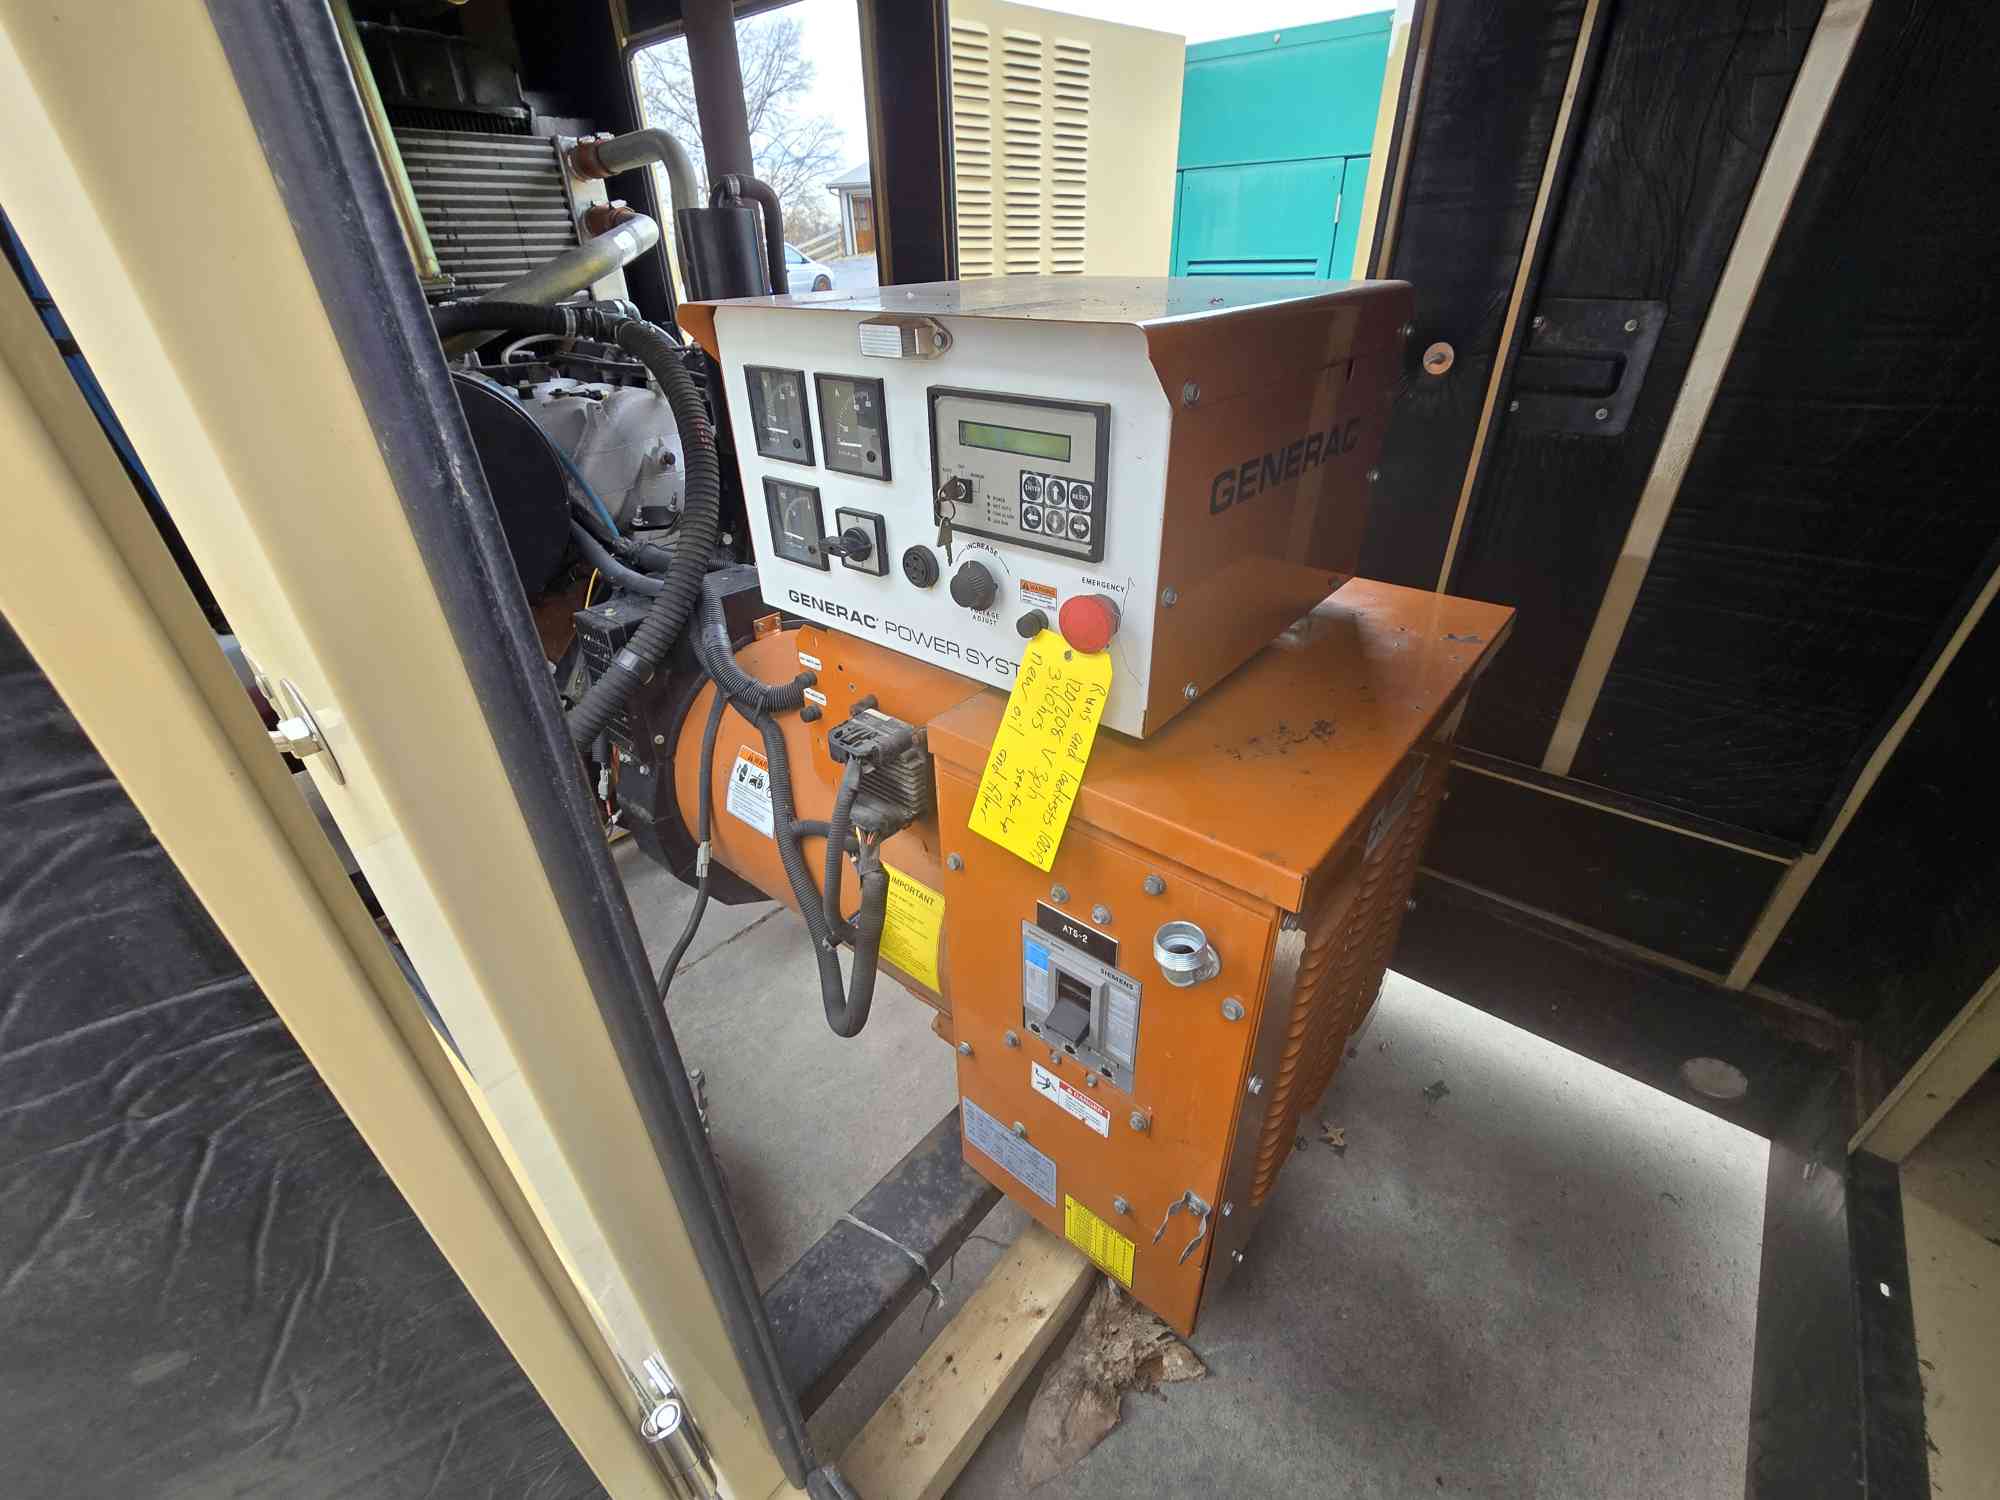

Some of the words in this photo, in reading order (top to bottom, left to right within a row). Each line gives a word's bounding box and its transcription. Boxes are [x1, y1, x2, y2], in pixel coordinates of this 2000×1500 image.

[1210, 417, 1361, 516] GENERAC
[967, 542, 999, 557] INCREASE
[1081, 576, 1125, 592] EMERGENCY
[788, 589, 877, 629] GENERAC
[884, 621, 961, 658] POWER
[966, 648, 1020, 680] SYST
[1080, 683, 1107, 722] Runs
[1007, 705, 1024, 737] oil
[1065, 733, 1086, 764] and
[991, 748, 1008, 781] and
[980, 781, 1004, 825] filter
[891, 875, 936, 906] IMPORTANT
[1062, 924, 1089, 944] ATS-2
[1100, 967, 1135, 991] SIEMENS
